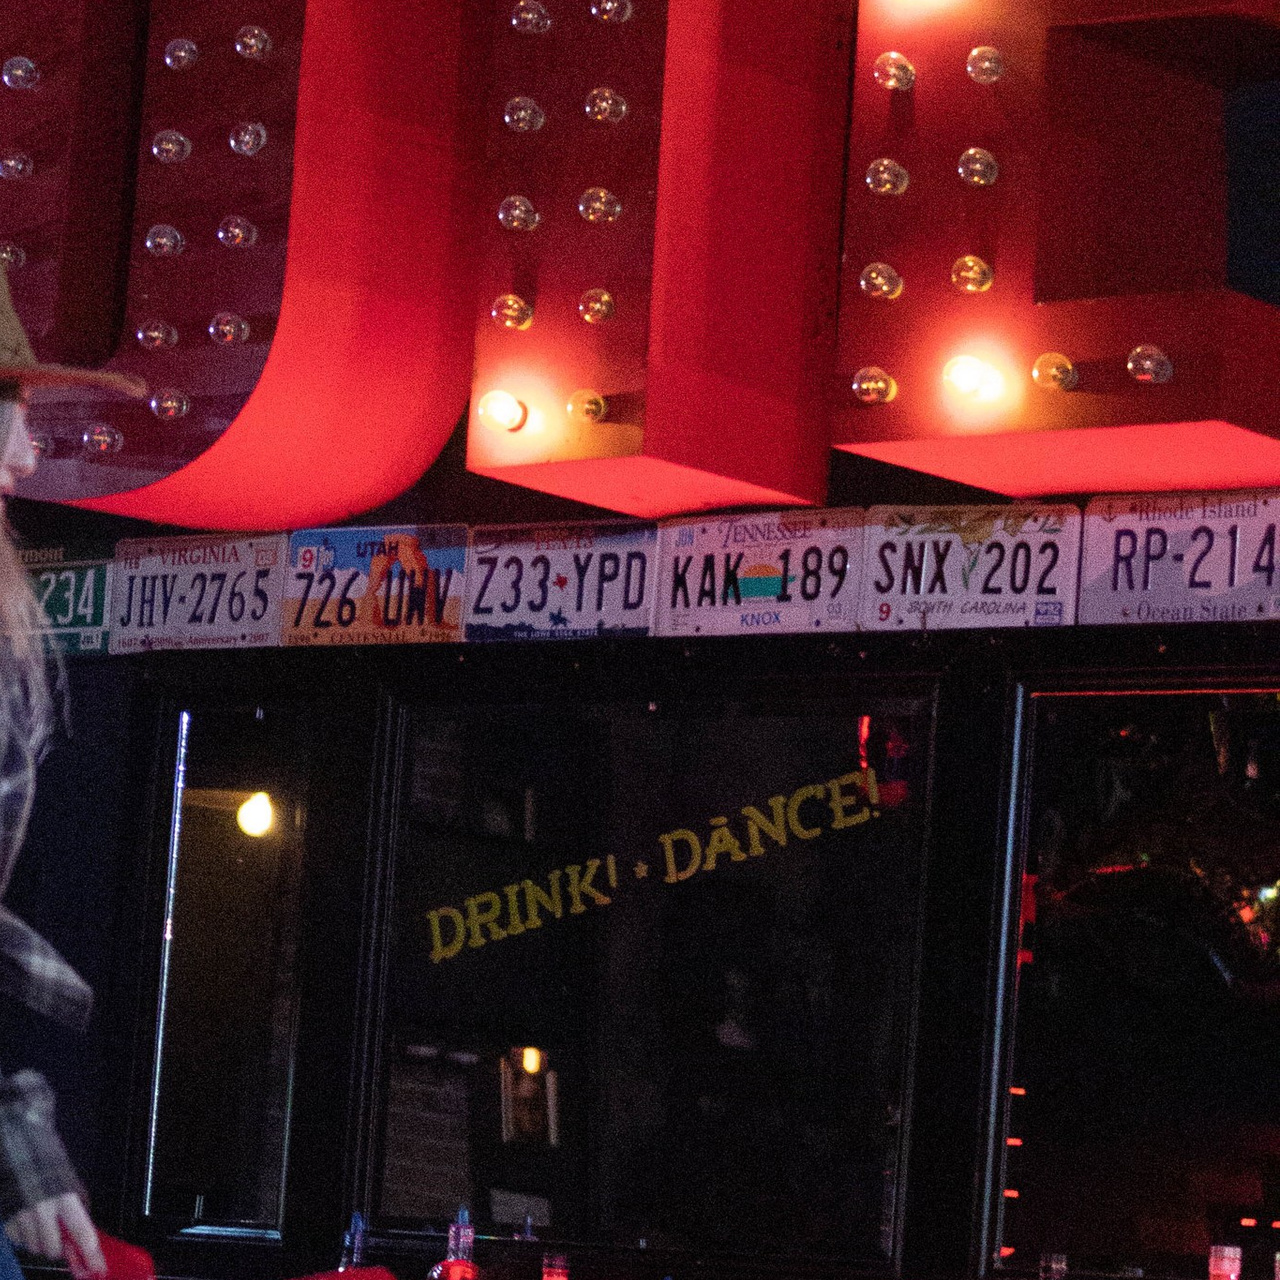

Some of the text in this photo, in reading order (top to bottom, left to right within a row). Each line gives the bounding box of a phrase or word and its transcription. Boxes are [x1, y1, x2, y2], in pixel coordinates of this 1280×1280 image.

[1137, 501, 1258, 524] Rhode Island
[719, 517, 813, 548] TENNESSEE
[157, 544, 240, 566] VIRGINIA
[301, 548, 314, 569] 9
[357, 540, 399, 558] UTAH
[1112, 523, 1277, 592] RP-214
[671, 545, 848, 608] KAK 189
[874, 540, 1060, 595] SNX 202
[473, 552, 647, 615] Z33 YPD
[293, 570, 360, 628] 726
[906, 601, 953, 615] SOUTH
[959, 601, 1028, 616] CAROLINA
[1136, 599, 1248, 622] Ocean State
[740, 610, 782, 627] KNOX
[878, 602, 892, 621] 9
[426, 853, 620, 963] DRINK!
